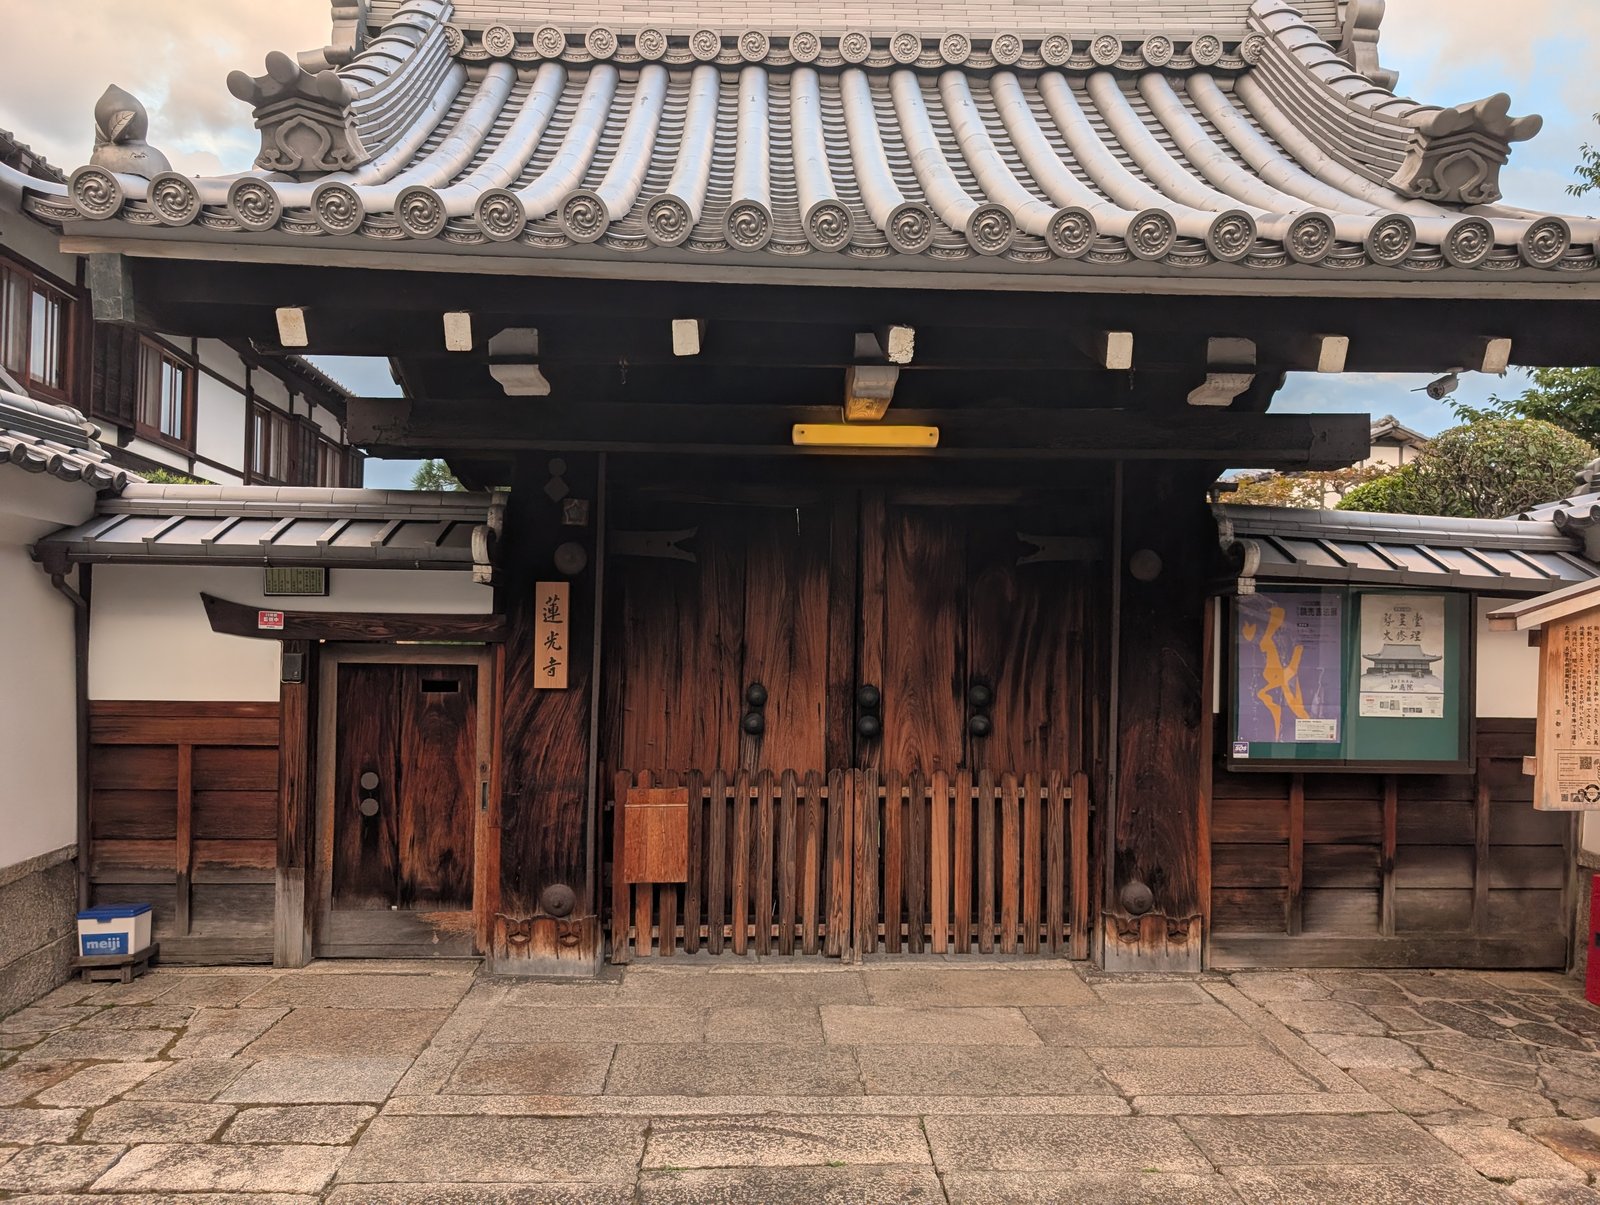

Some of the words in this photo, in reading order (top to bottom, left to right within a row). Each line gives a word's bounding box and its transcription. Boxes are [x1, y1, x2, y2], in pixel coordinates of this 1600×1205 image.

[542, 594, 563, 677] 蓮光寺
[86, 938, 120, 951] meiji
